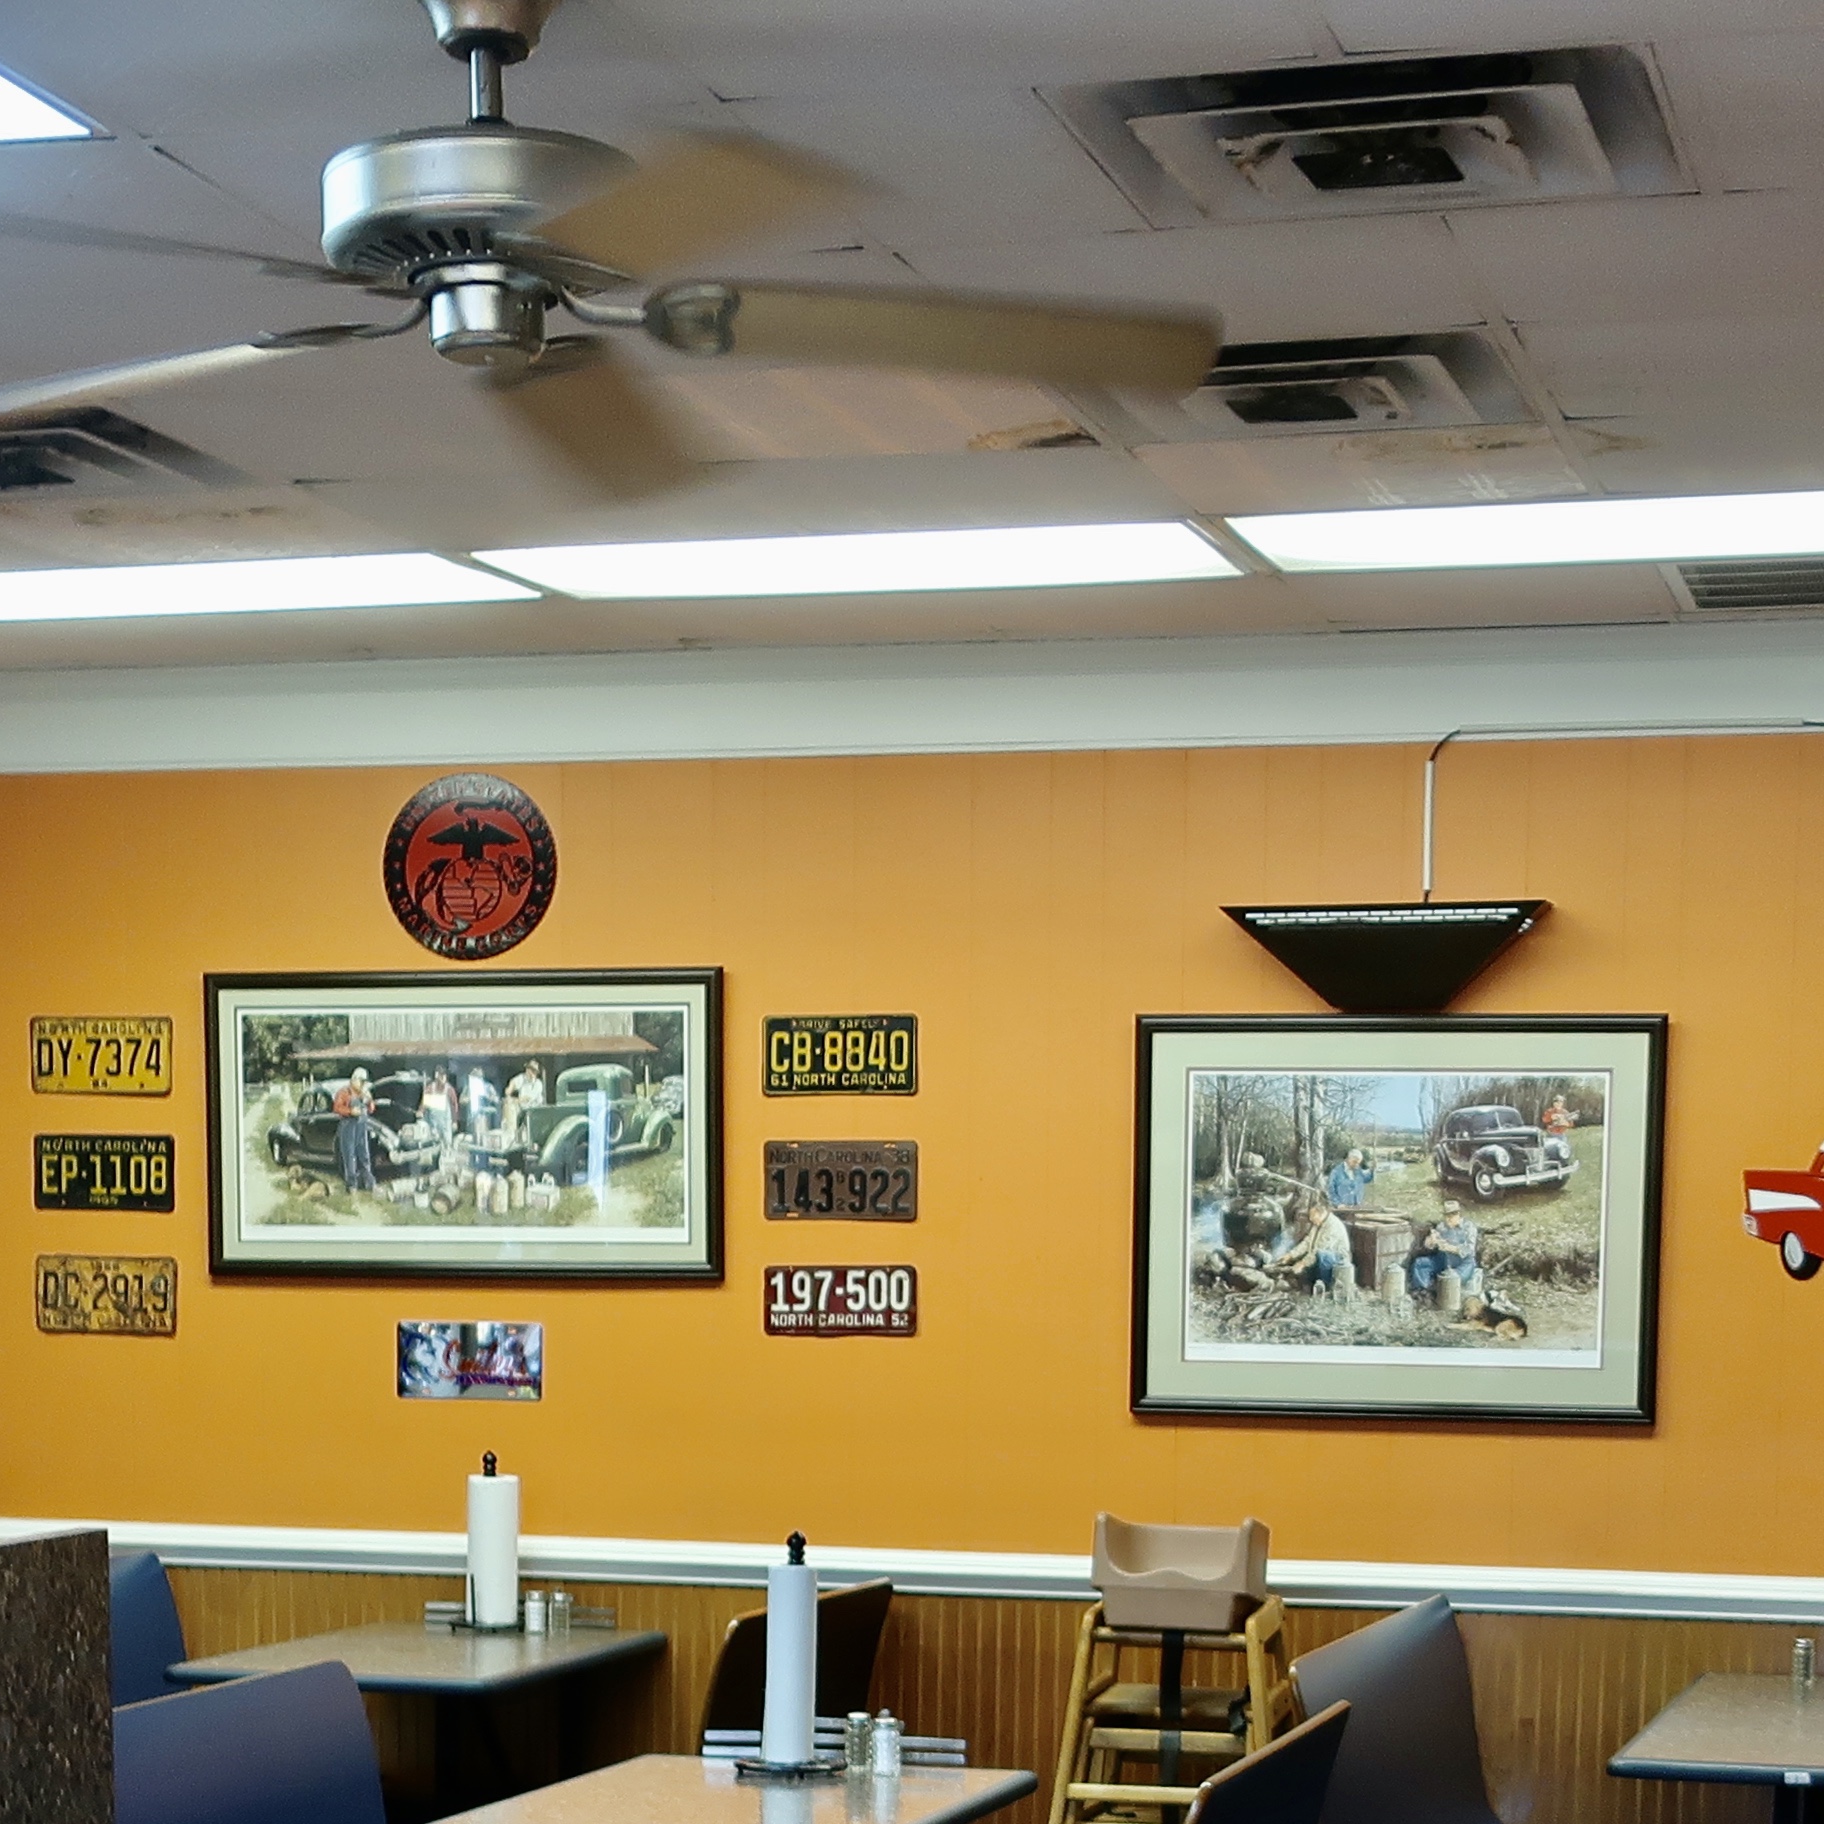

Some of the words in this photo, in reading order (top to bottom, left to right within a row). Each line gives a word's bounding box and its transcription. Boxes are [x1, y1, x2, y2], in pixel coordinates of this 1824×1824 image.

[399, 896, 465, 950] MARINE
[475, 904, 539, 951] CORPS
[91, 1022, 162, 1036] CAROLINA
[770, 1073, 789, 1087] 61
[793, 1073, 836, 1086] NORTH
[841, 1072, 907, 1086] CAROLINA
[42, 1138, 91, 1152] NORTH
[95, 1138, 167, 1153] CAROLINA
[769, 1149, 814, 1164] NORTH
[815, 1149, 882, 1164] CAROLINA
[770, 1269, 910, 1313] 197-500
[770, 1313, 813, 1326] NORTH
[818, 1313, 884, 1326] CAROLINA
[891, 1313, 909, 1326] 52
